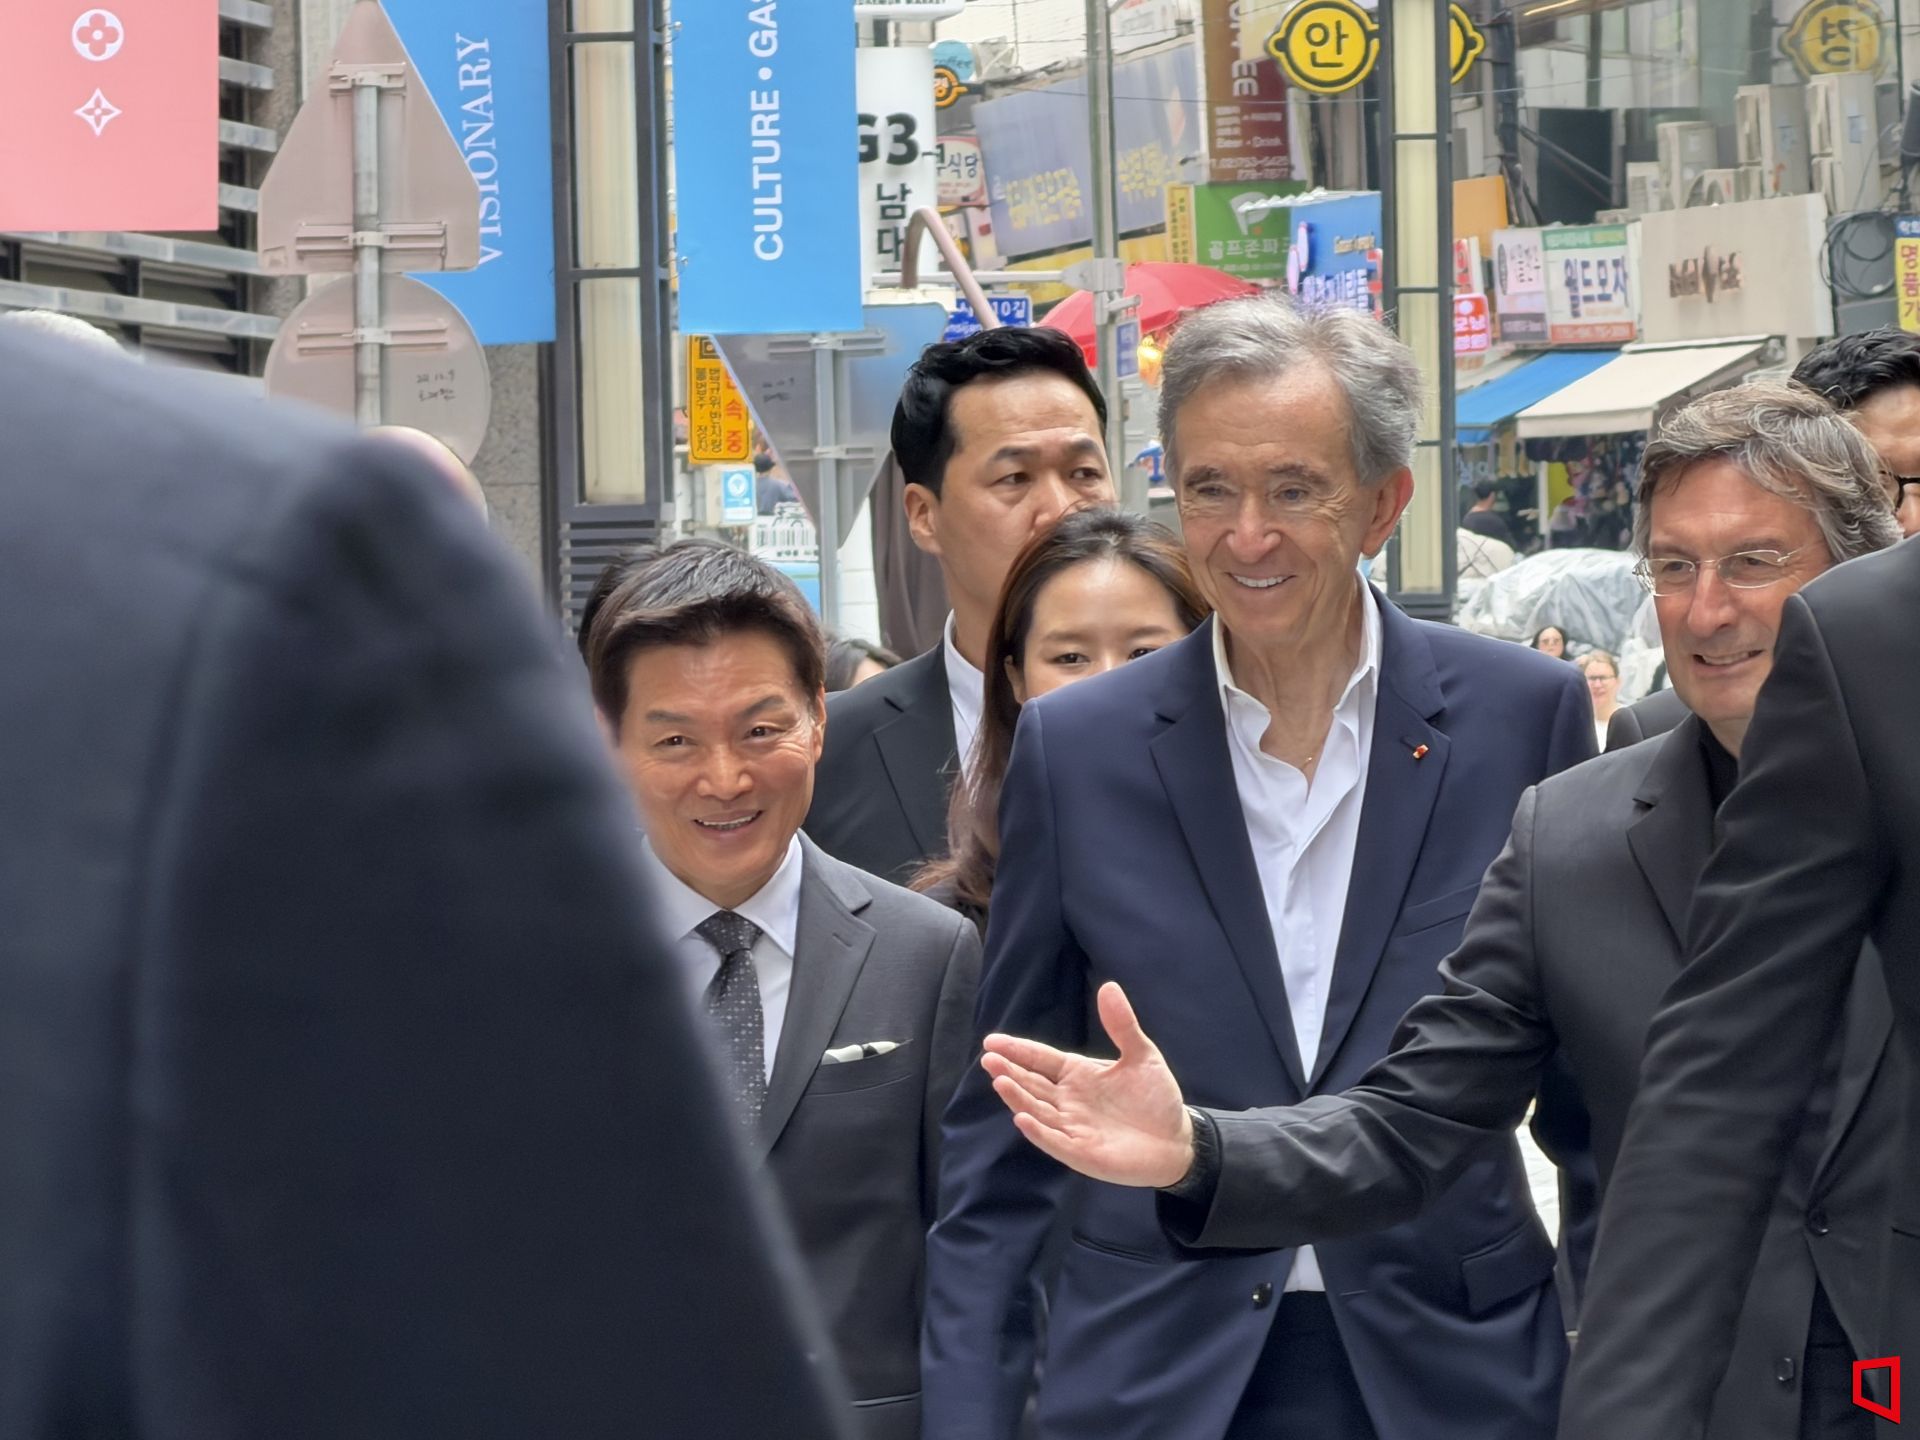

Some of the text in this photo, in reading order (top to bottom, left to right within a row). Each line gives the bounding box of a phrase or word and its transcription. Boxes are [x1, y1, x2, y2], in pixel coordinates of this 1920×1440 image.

[1305, 19, 1349, 69] 안
[455, 32, 503, 265] VISIONARY
[748, 0, 784, 261] CULTURE GA
[936, 152, 979, 179] 식당
[876, 183, 913, 274] 남대
[1564, 256, 1630, 318] 월드모자
